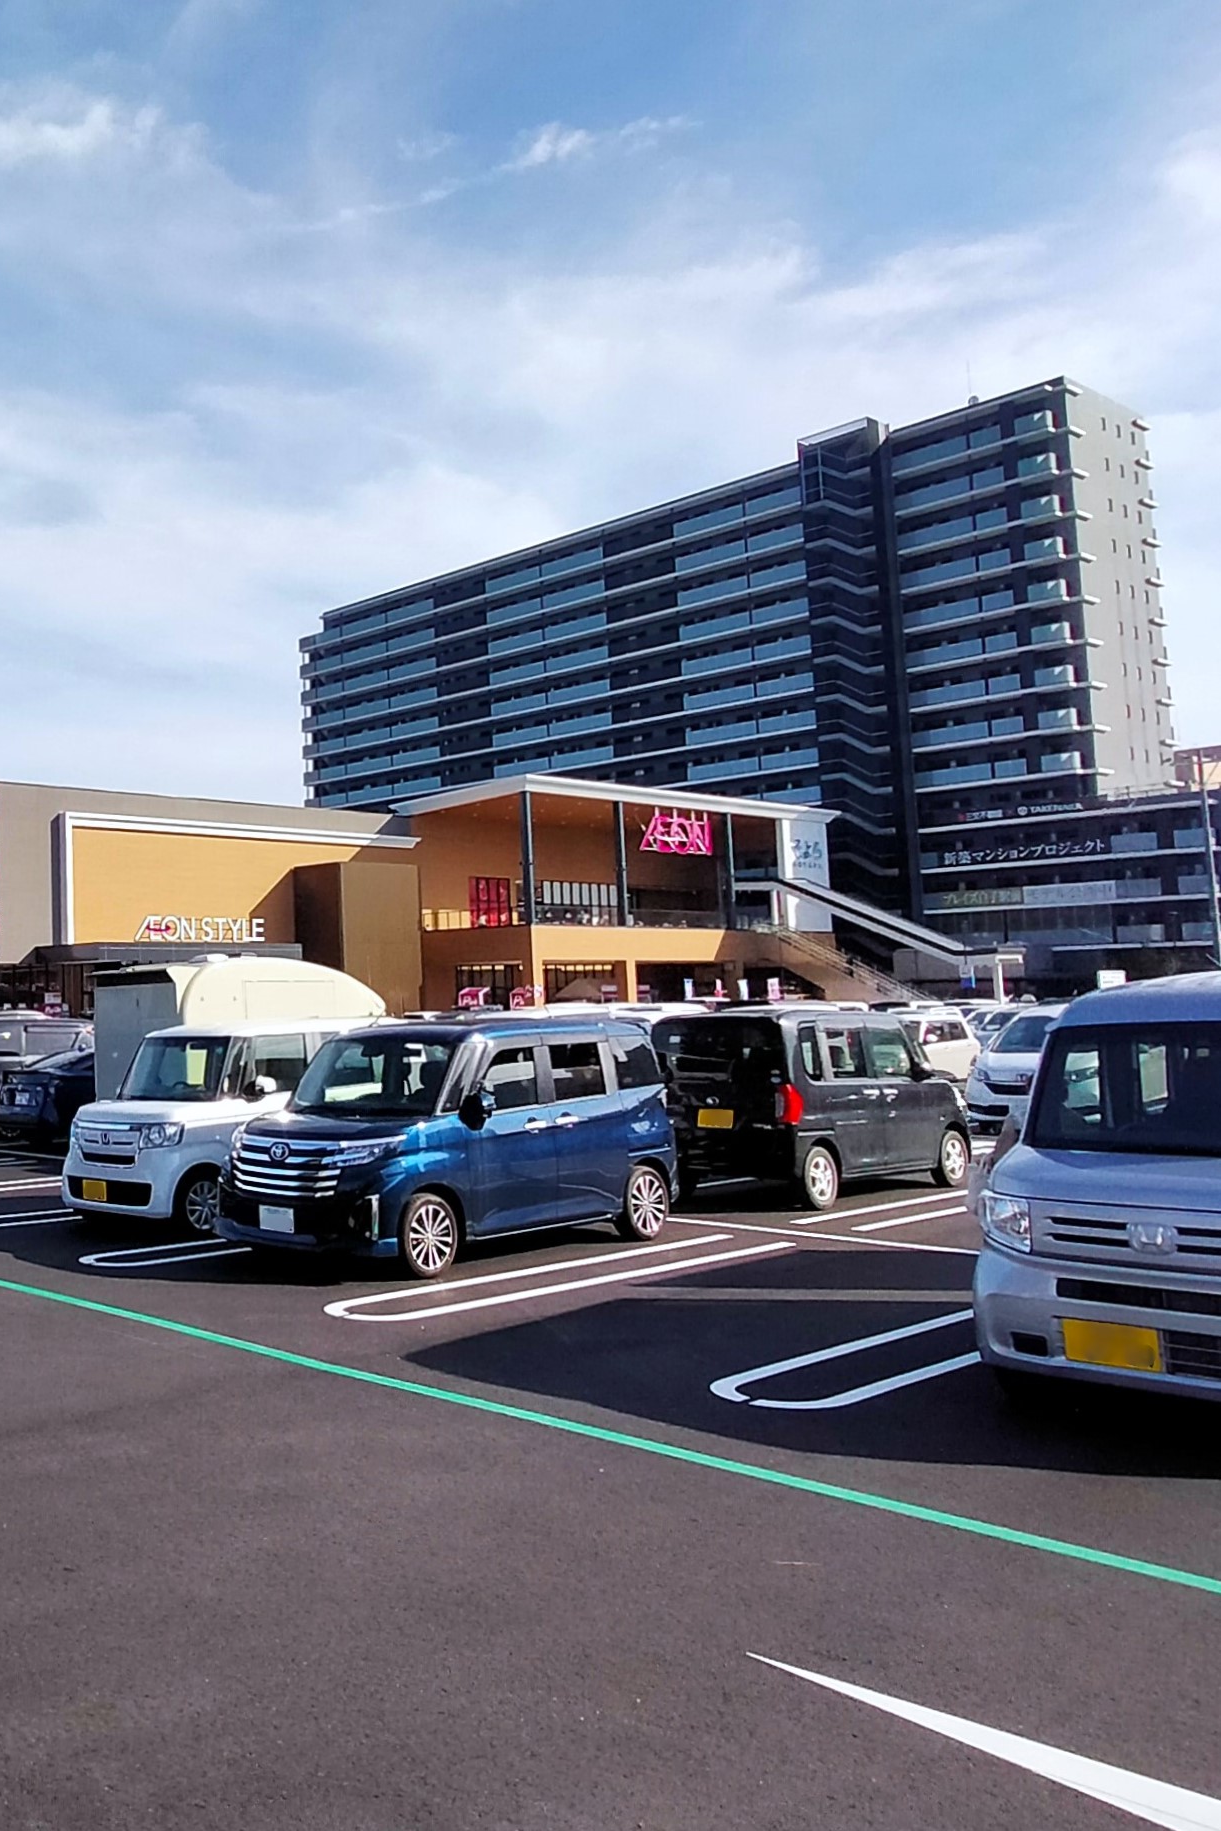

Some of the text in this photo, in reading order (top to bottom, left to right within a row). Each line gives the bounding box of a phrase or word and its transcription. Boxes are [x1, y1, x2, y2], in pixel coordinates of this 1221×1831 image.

[943, 838, 1105, 866] 新築マンションプロジェクト
[201, 917, 265, 942] STYLE
